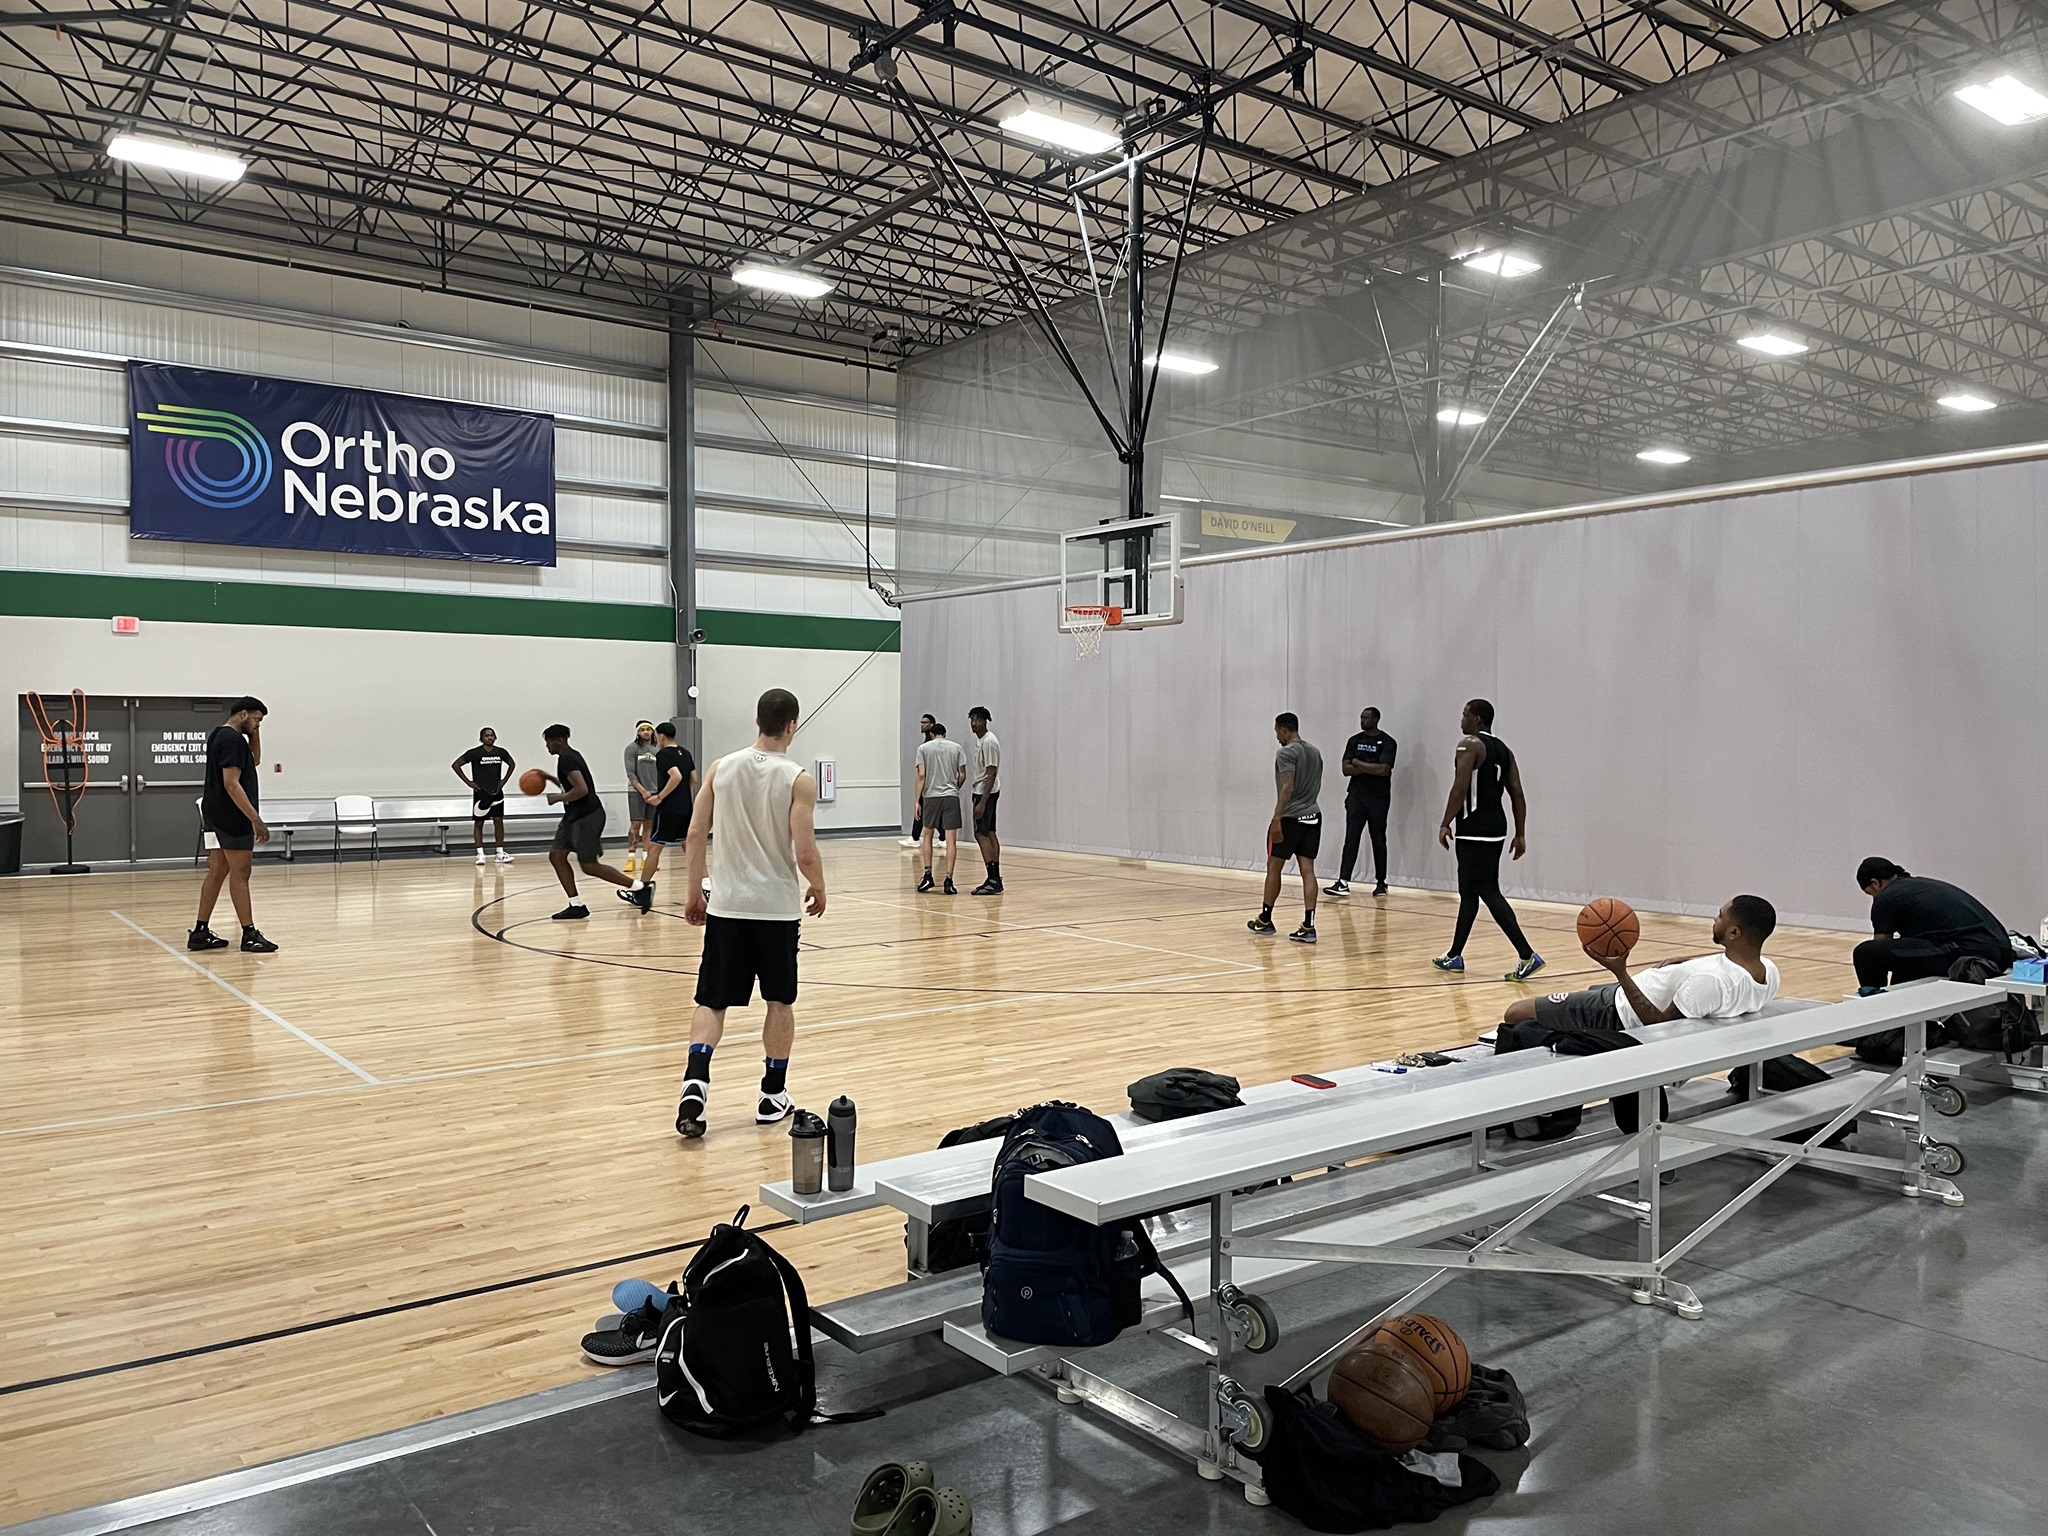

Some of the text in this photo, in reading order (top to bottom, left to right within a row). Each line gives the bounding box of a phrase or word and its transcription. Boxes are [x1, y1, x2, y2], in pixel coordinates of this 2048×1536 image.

[281, 421, 456, 481] Ortho
[284, 469, 550, 536] Nebraska
[1210, 517, 1276, 534] DAVID O'NEILL
[163, 731, 206, 741] DO NOT BLOCK
[95, 743, 112, 752] ONLY
[151, 743, 187, 752] EMERGENCY
[188, 743, 202, 752] EXIT
[87, 754, 109, 764] SOUND
[154, 755, 208, 764] ALARMS WILL SOU
